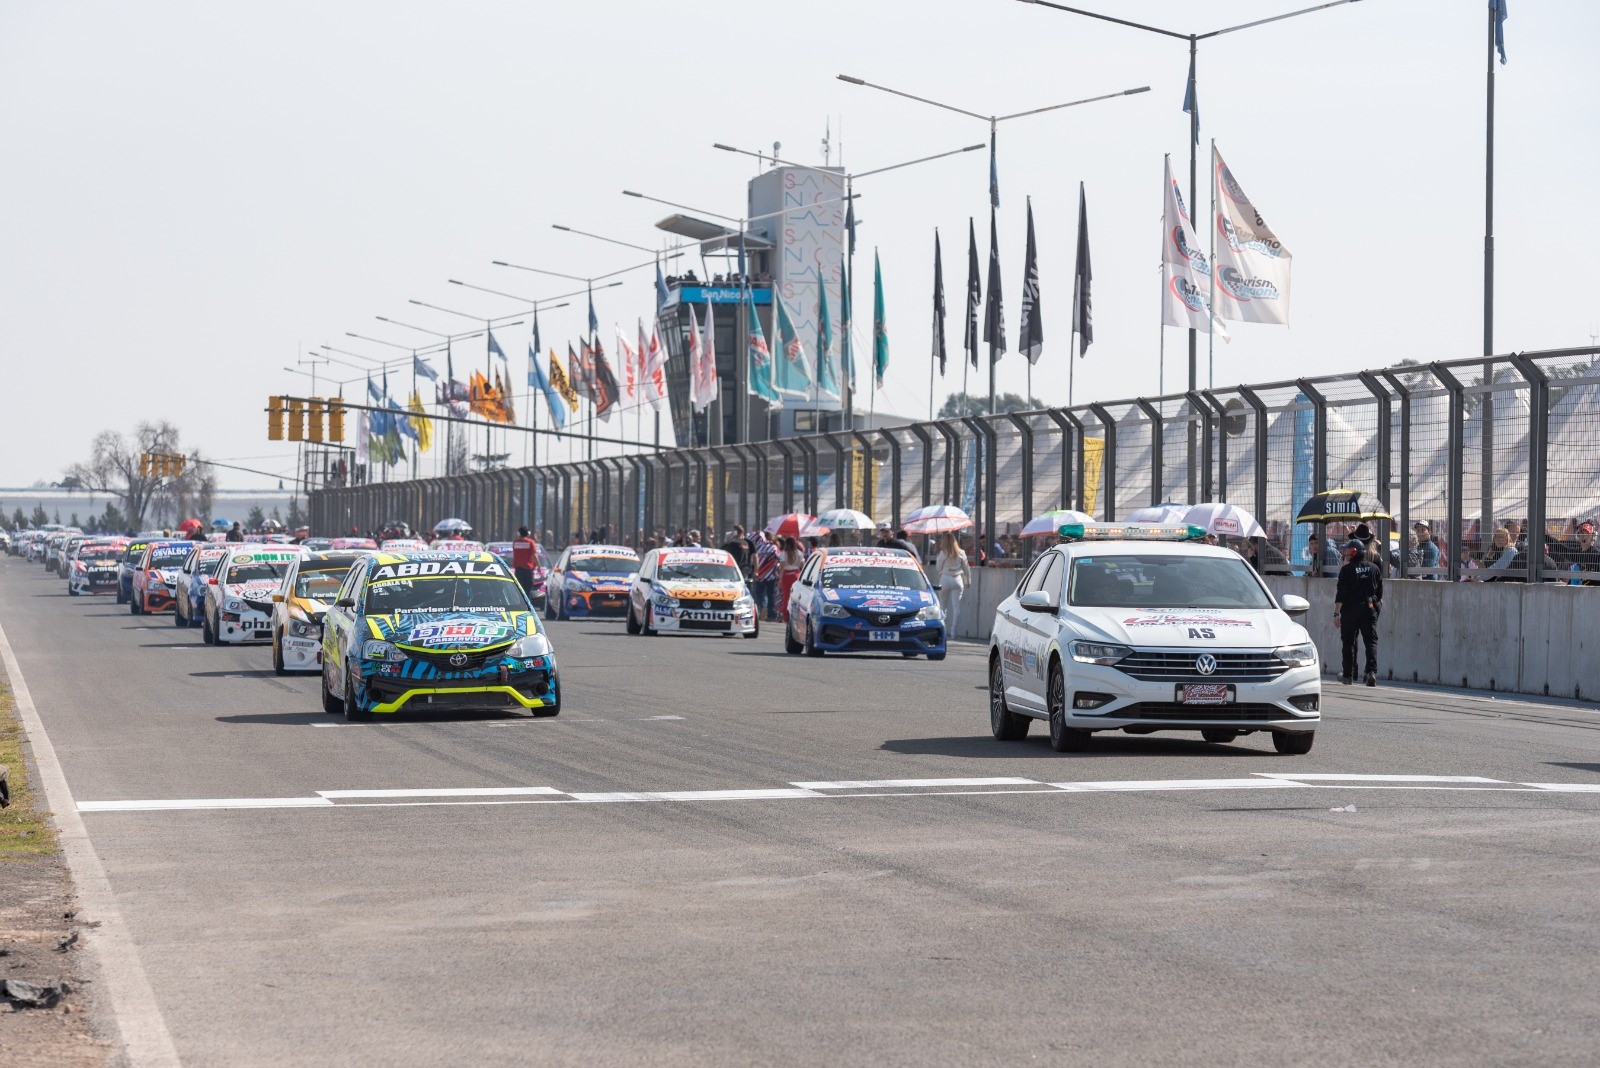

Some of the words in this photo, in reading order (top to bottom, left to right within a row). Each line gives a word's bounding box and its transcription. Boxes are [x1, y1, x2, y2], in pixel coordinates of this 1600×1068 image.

[1326, 502, 1357, 514] SIMIA
[372, 561, 506, 581] ABDALA
[452, 605, 506, 613] Pergamino
[299, 625, 307, 635] 6
[1187, 627, 1216, 639] AS
